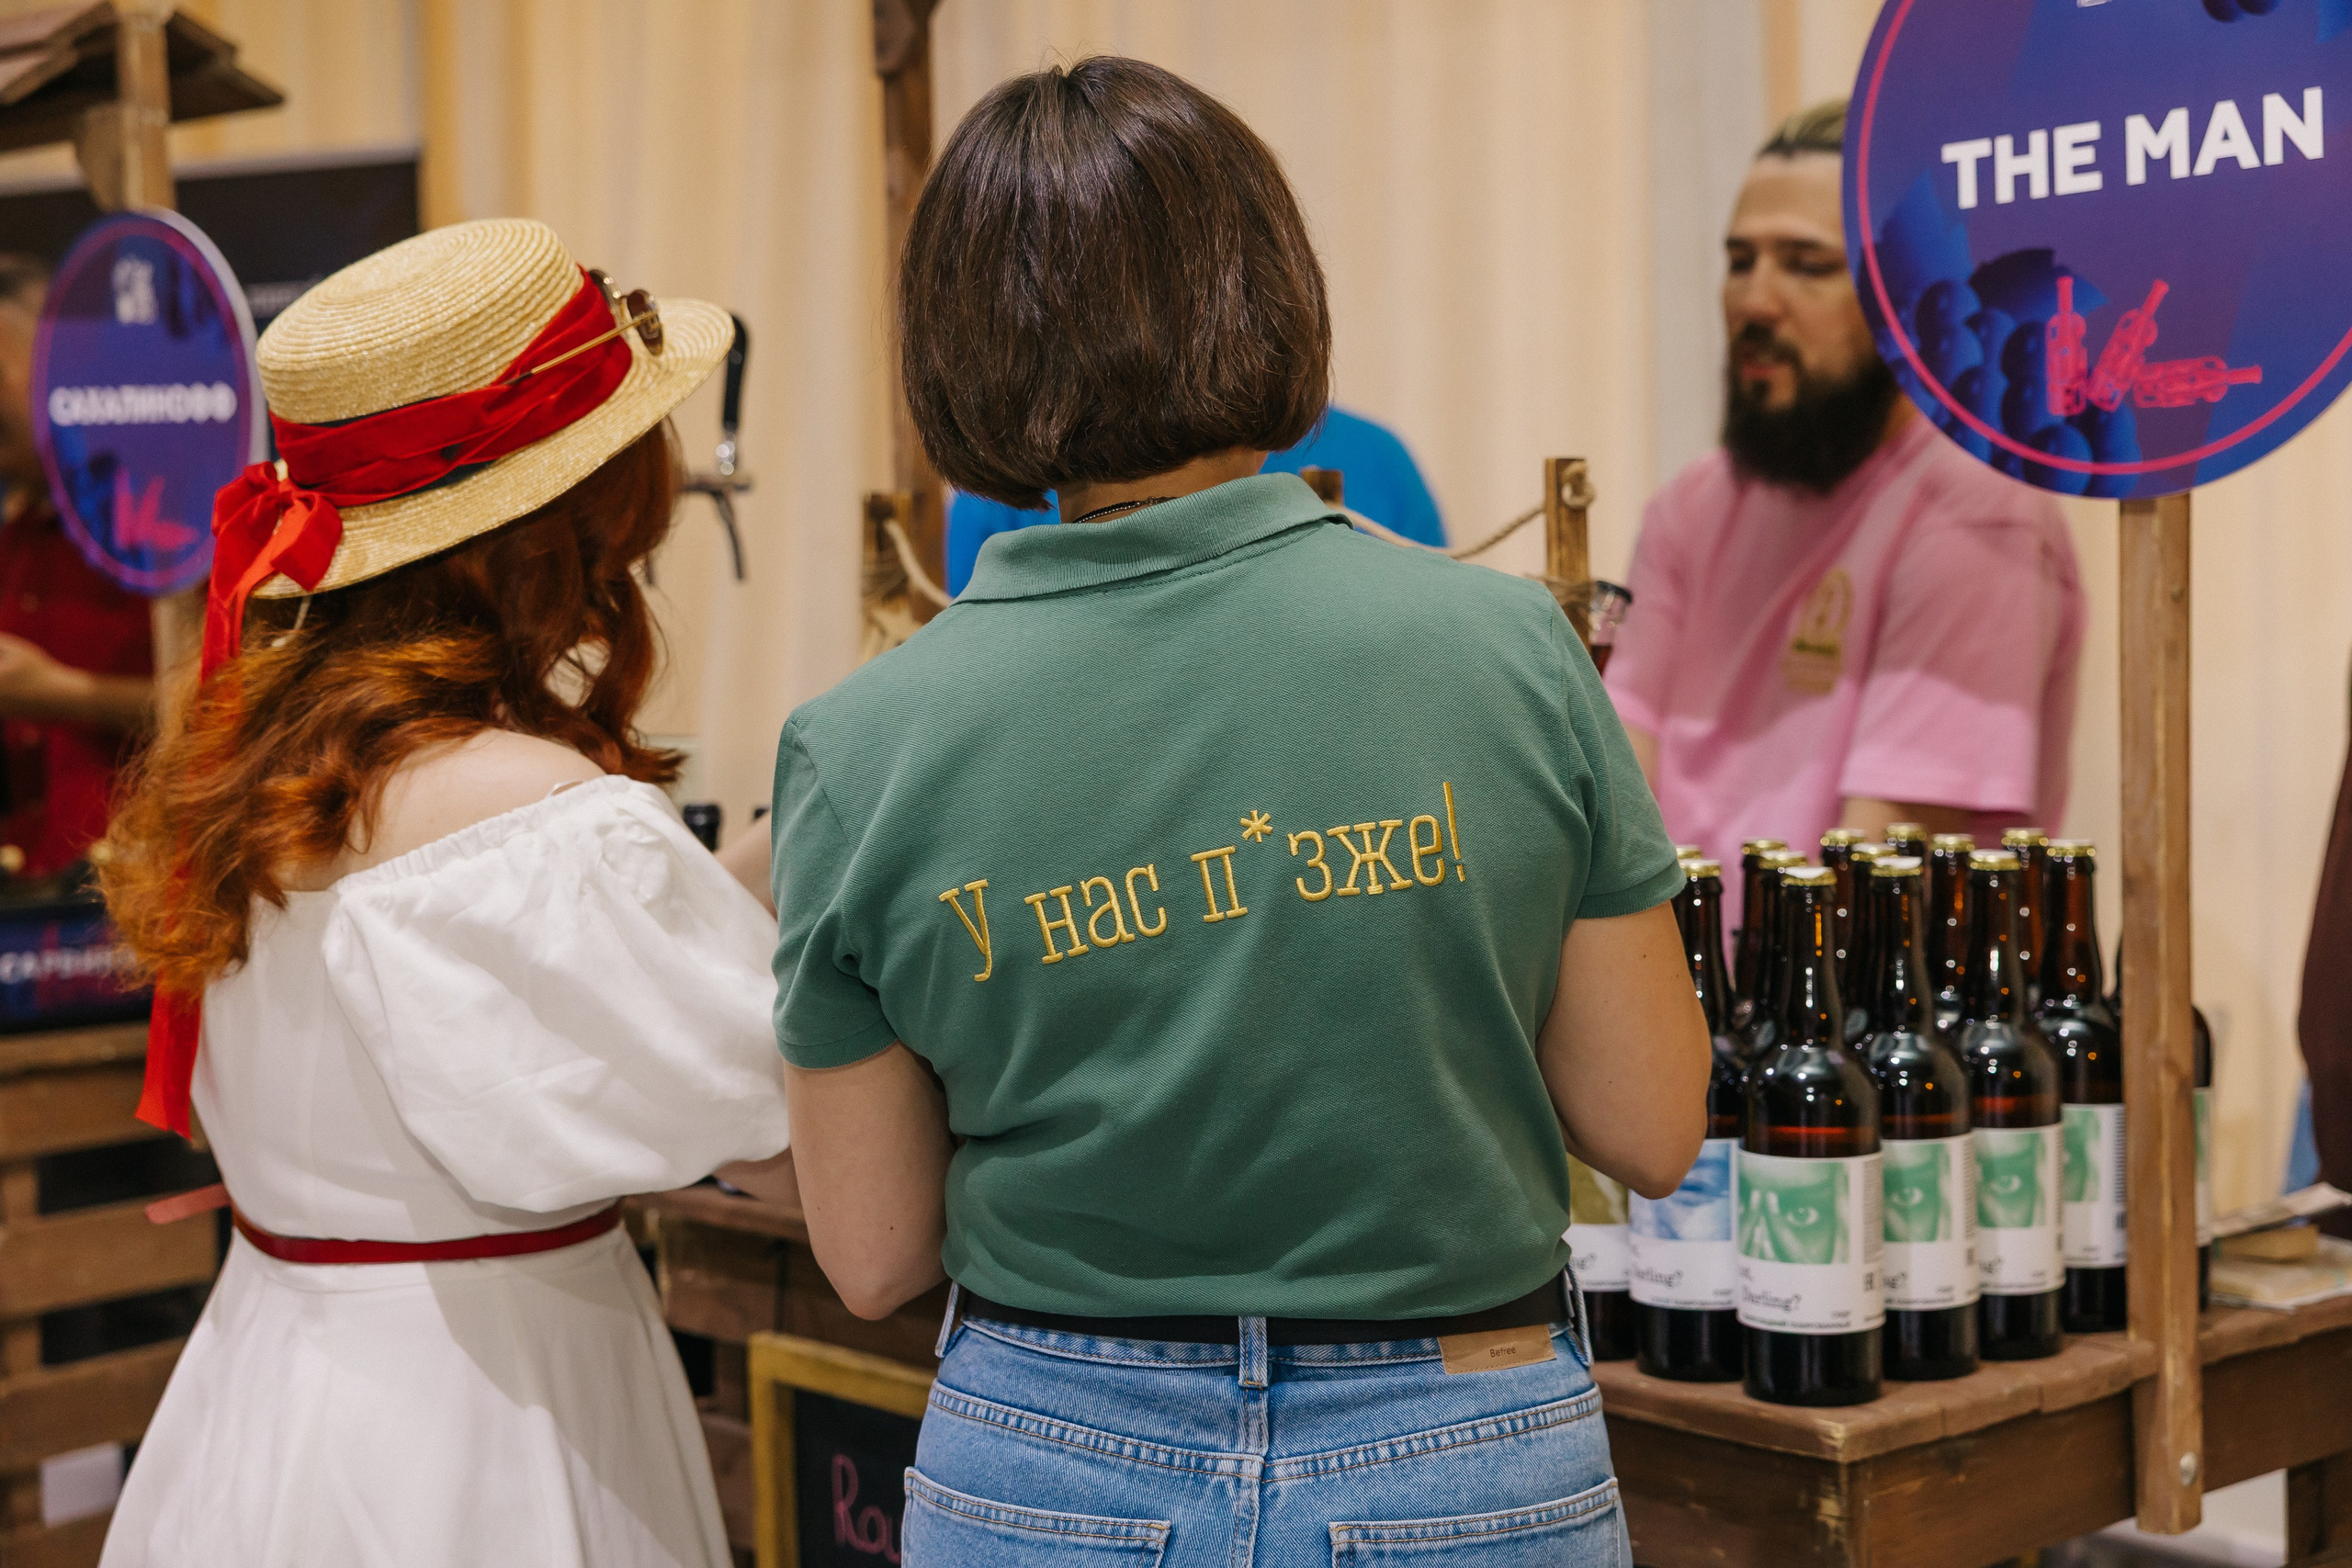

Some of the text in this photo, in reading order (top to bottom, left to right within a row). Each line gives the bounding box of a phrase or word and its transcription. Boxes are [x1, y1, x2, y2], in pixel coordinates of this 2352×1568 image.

[1940, 86, 2324, 209] THE MAN
[938, 878, 992, 982] у
[1023, 863, 1169, 964] нас
[1489, 1345, 1517, 1359] Befree
